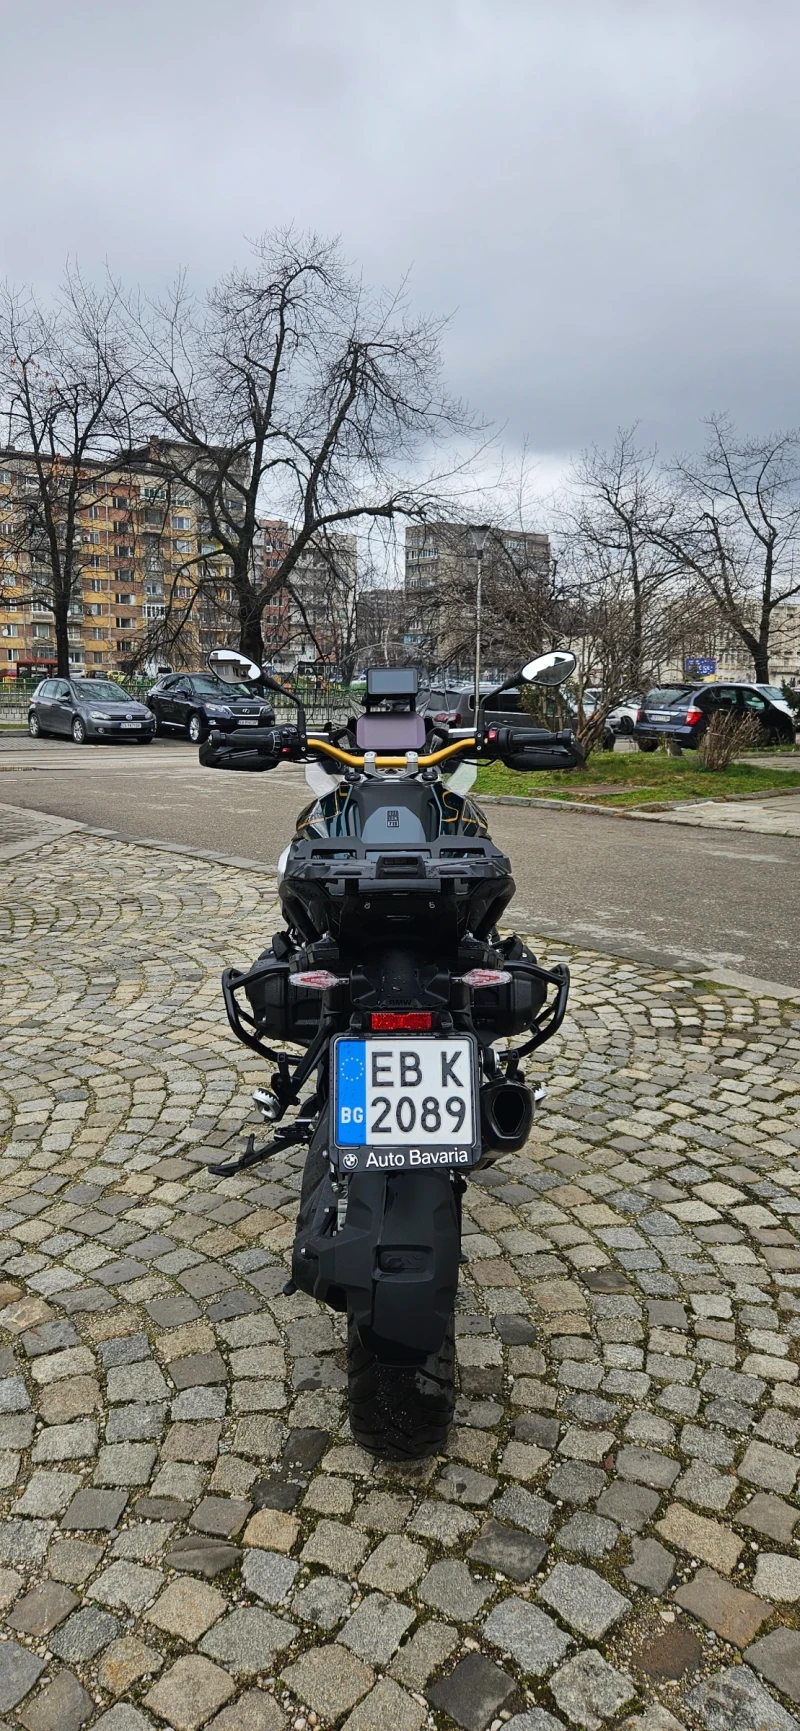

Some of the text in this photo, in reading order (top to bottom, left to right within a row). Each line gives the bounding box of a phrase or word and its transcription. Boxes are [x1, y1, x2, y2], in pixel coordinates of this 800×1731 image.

[371, 1051, 465, 1088] EB K
[341, 1106, 364, 1124] BG
[370, 1096, 466, 1133] 2089
[365, 1147, 469, 1168] Auto Bavaria
